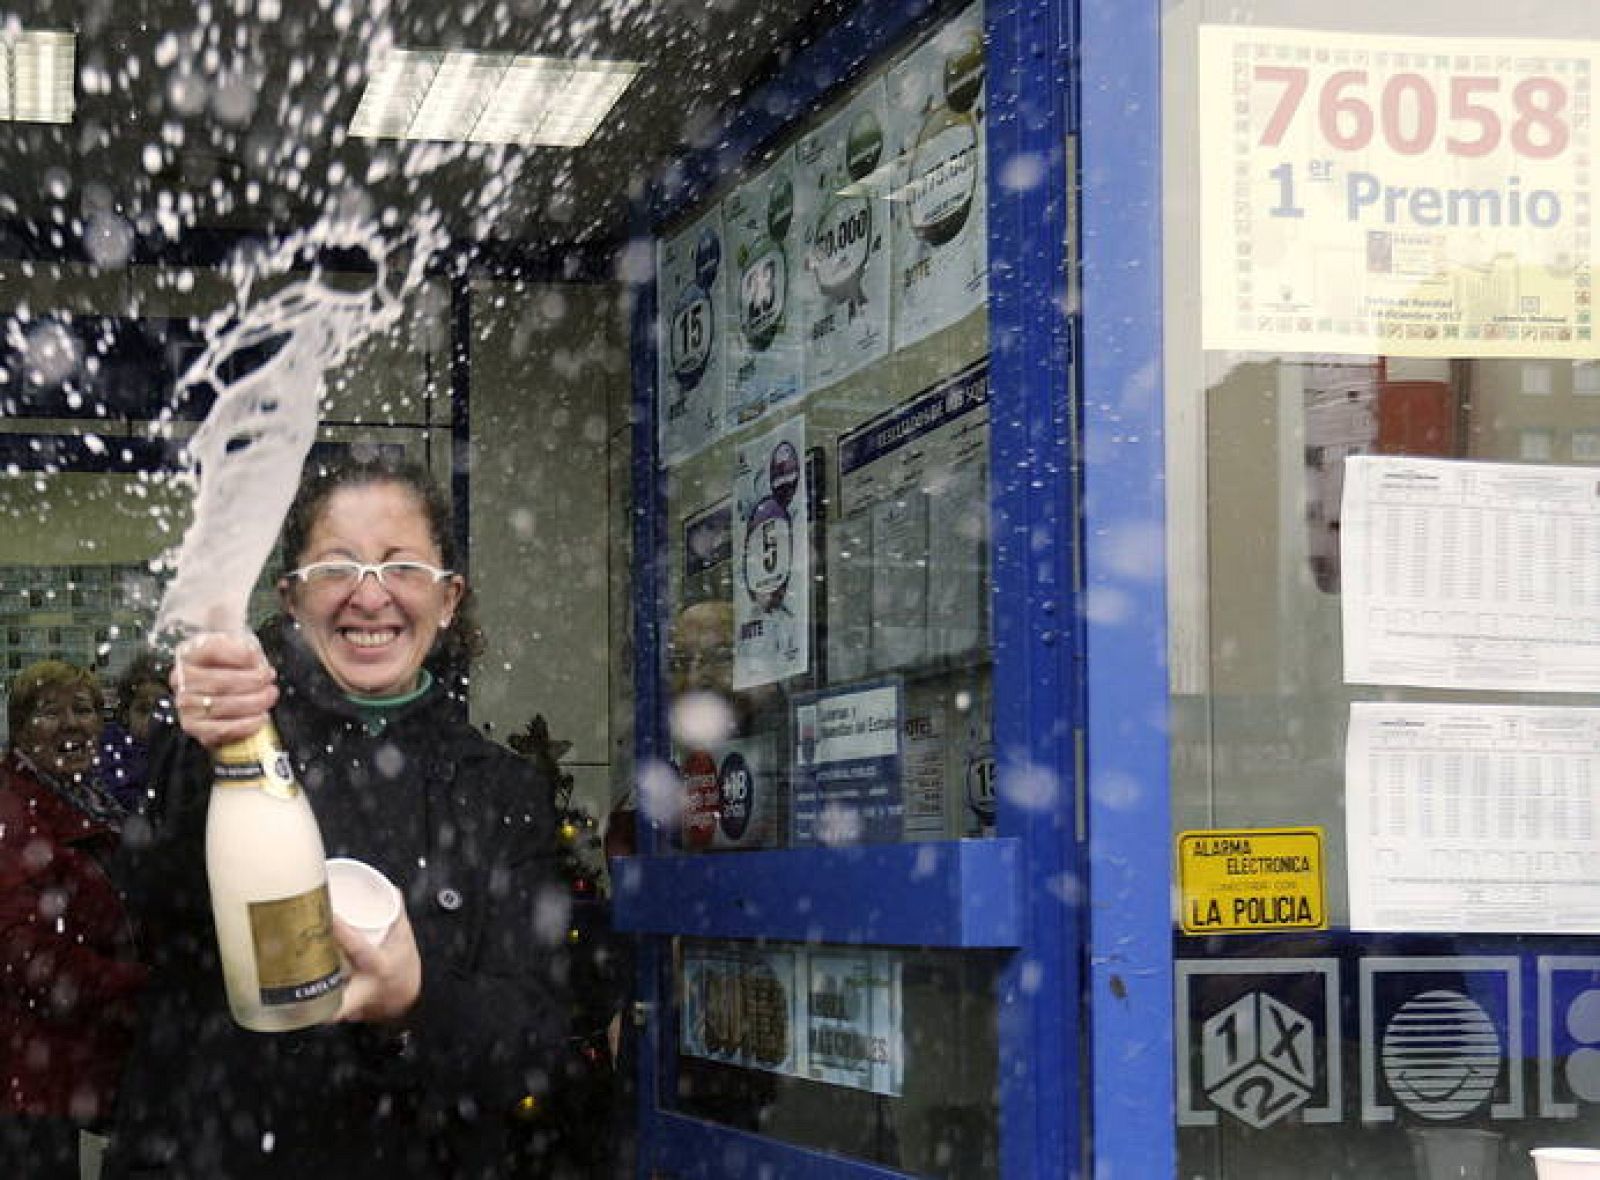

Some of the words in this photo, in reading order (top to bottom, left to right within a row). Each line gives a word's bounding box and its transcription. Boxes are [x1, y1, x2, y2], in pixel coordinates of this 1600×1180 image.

[1253, 66, 1570, 160] 76058
[1347, 171, 1562, 228] Premio
[680, 303, 703, 354] 15
[762, 519, 777, 574] 5
[1193, 840, 1251, 857] ALARMA
[1227, 856, 1310, 875] ELECTRONICA
[1193, 898, 1221, 926] LA
[1234, 895, 1312, 925] POLICIA
